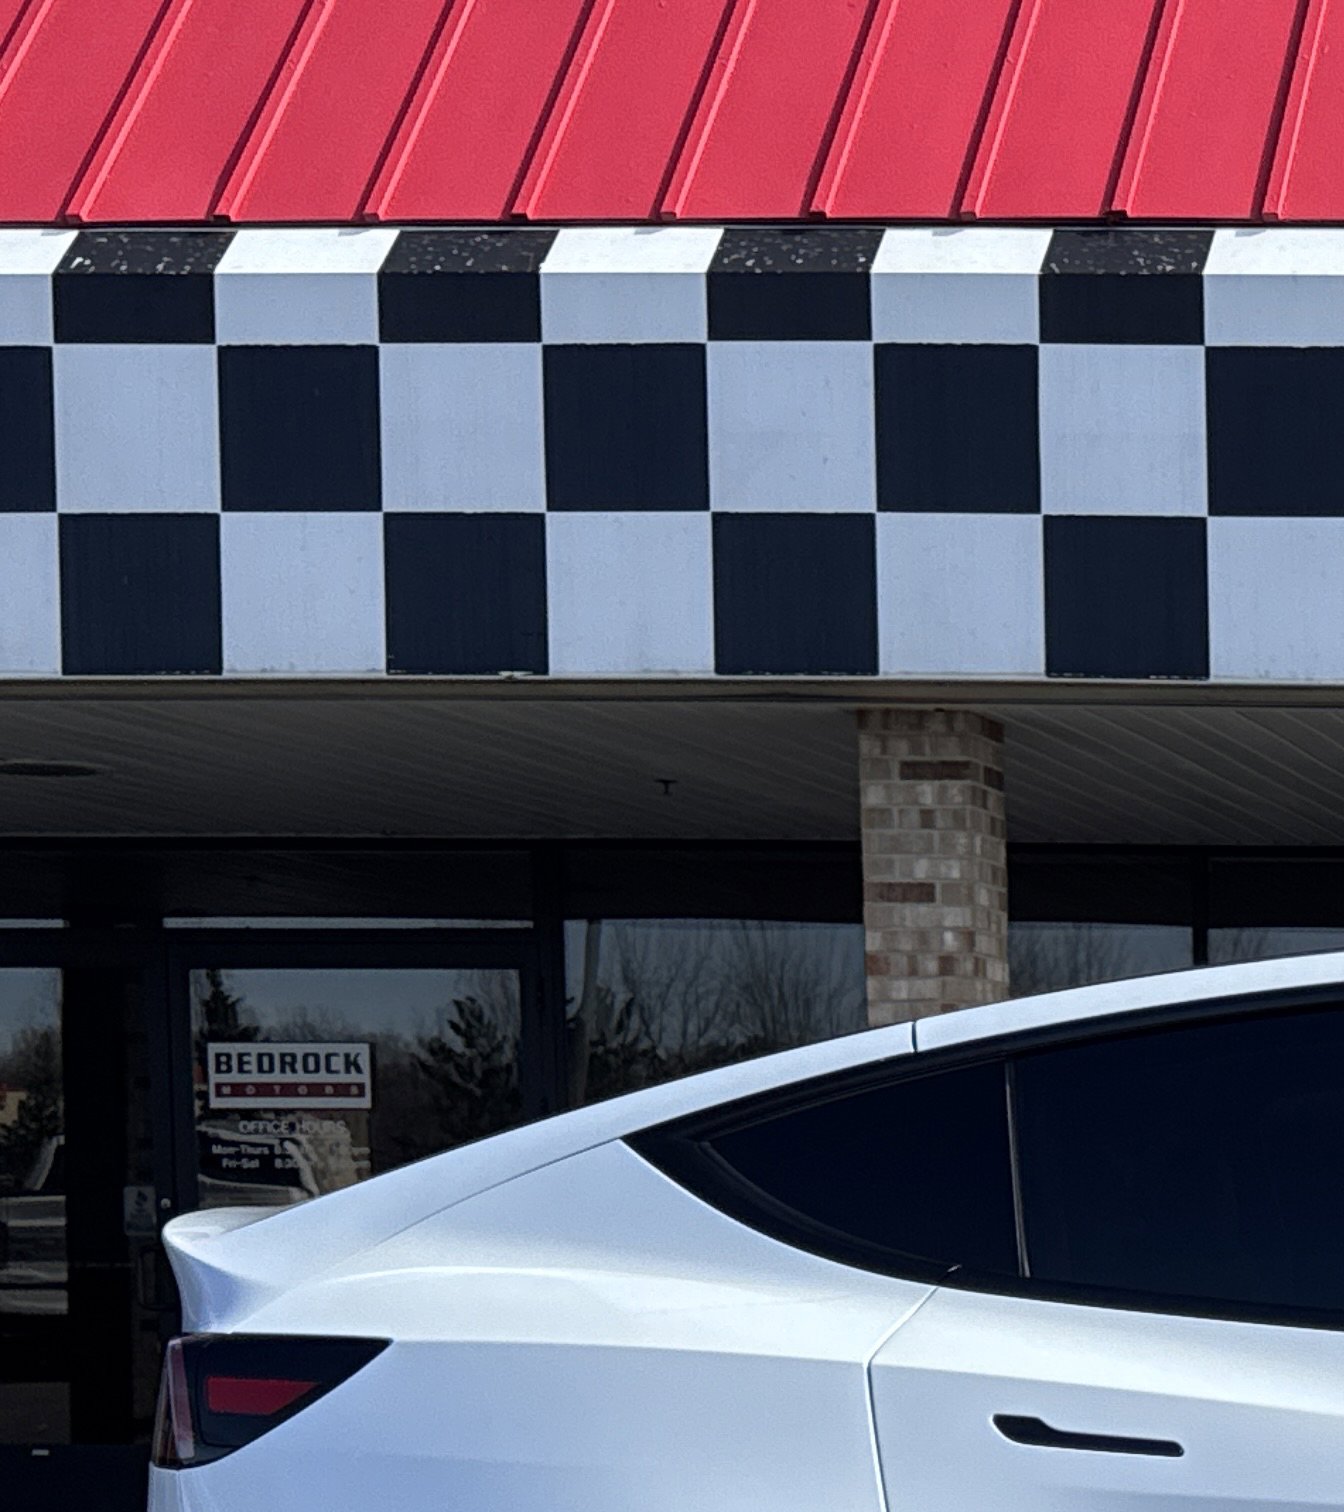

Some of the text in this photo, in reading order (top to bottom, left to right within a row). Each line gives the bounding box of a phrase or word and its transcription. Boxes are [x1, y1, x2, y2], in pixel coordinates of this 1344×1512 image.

[214, 1052, 364, 1075] BEDROCK
[220, 1084, 360, 1095] MOTORS
[238, 1120, 290, 1134] OFFICE
